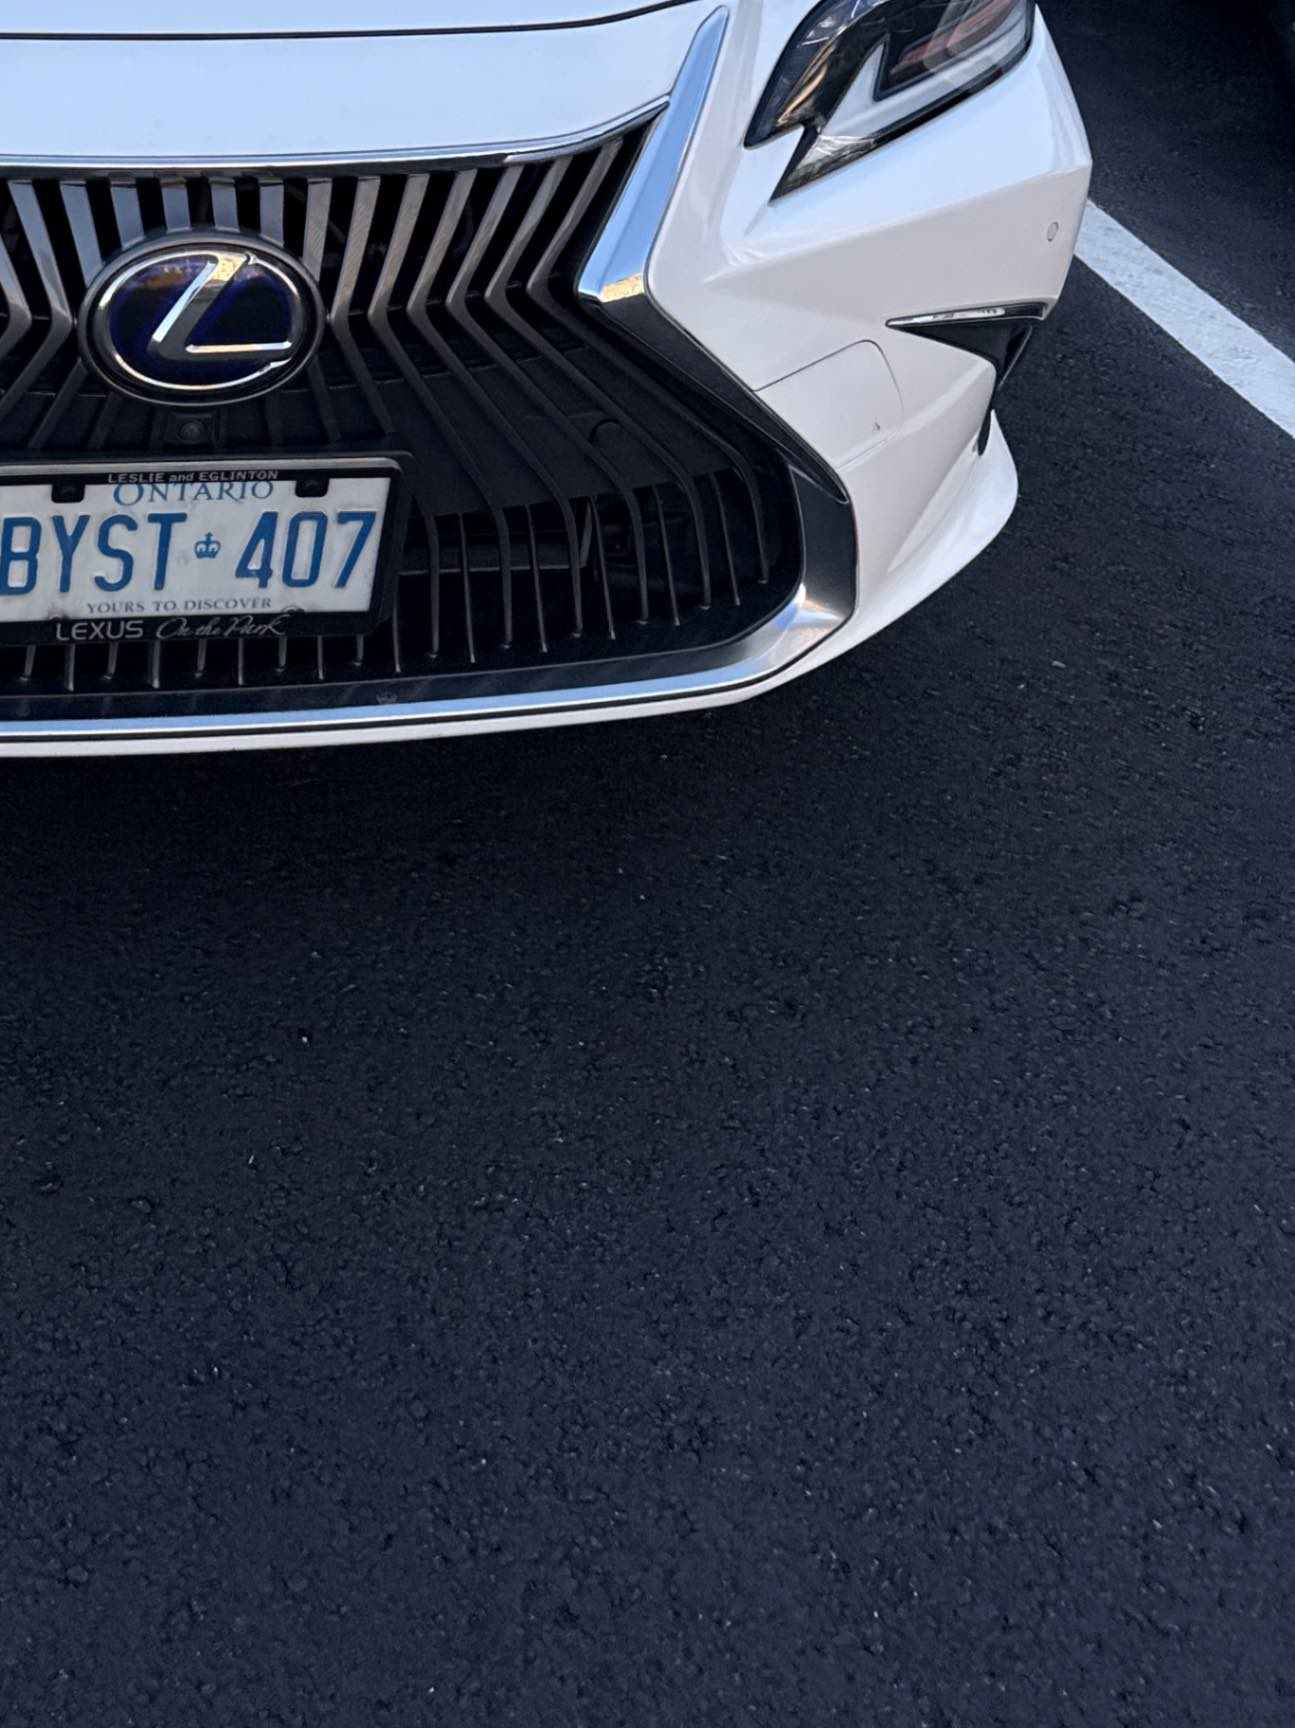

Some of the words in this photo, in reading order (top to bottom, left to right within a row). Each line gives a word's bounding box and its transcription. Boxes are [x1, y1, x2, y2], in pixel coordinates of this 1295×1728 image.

[108, 472, 165, 484] LESLIE
[169, 472, 194, 483] and
[199, 470, 279, 482] EGLINTON
[113, 480, 273, 506] ONTARIO
[234, 511, 377, 589] 407
[87, 600, 145, 615] YOURS
[153, 600, 177, 612] TO
[184, 597, 272, 610] DISCOVER
[56, 619, 144, 641] LEXUS
